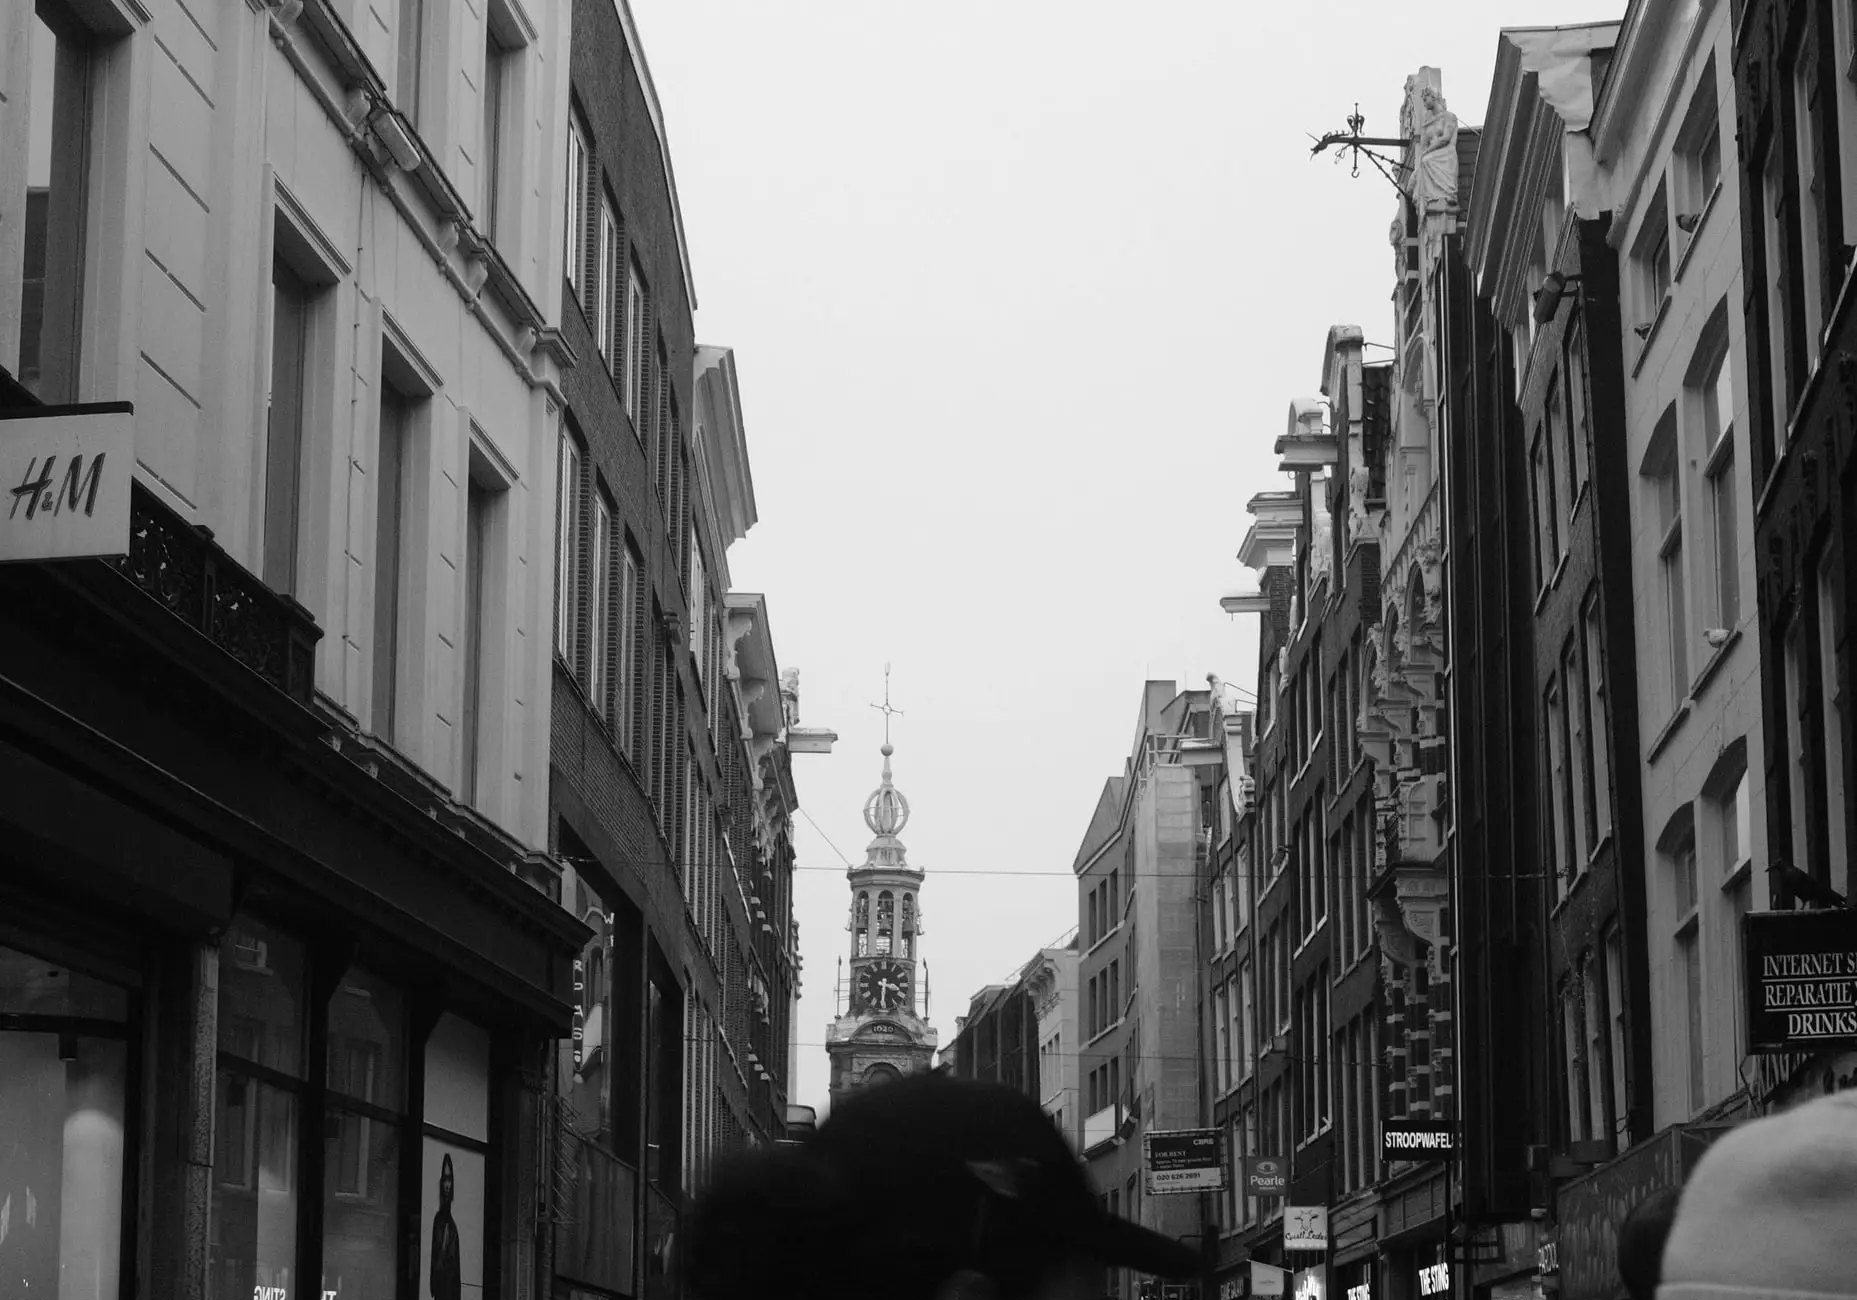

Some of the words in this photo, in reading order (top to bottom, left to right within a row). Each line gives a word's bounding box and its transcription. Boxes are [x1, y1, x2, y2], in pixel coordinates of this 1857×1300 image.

[10, 452, 106, 520] H&M
[1762, 952, 1843, 977] INTERNET
[1847, 952, 1857, 974] S
[1764, 982, 1852, 1006] REPARATIE
[1788, 1011, 1857, 1035] DRINKS
[1249, 1174, 1286, 1187] Pearle
[1418, 1266, 1432, 1297] THE
[1430, 1262, 1449, 1294] STING
